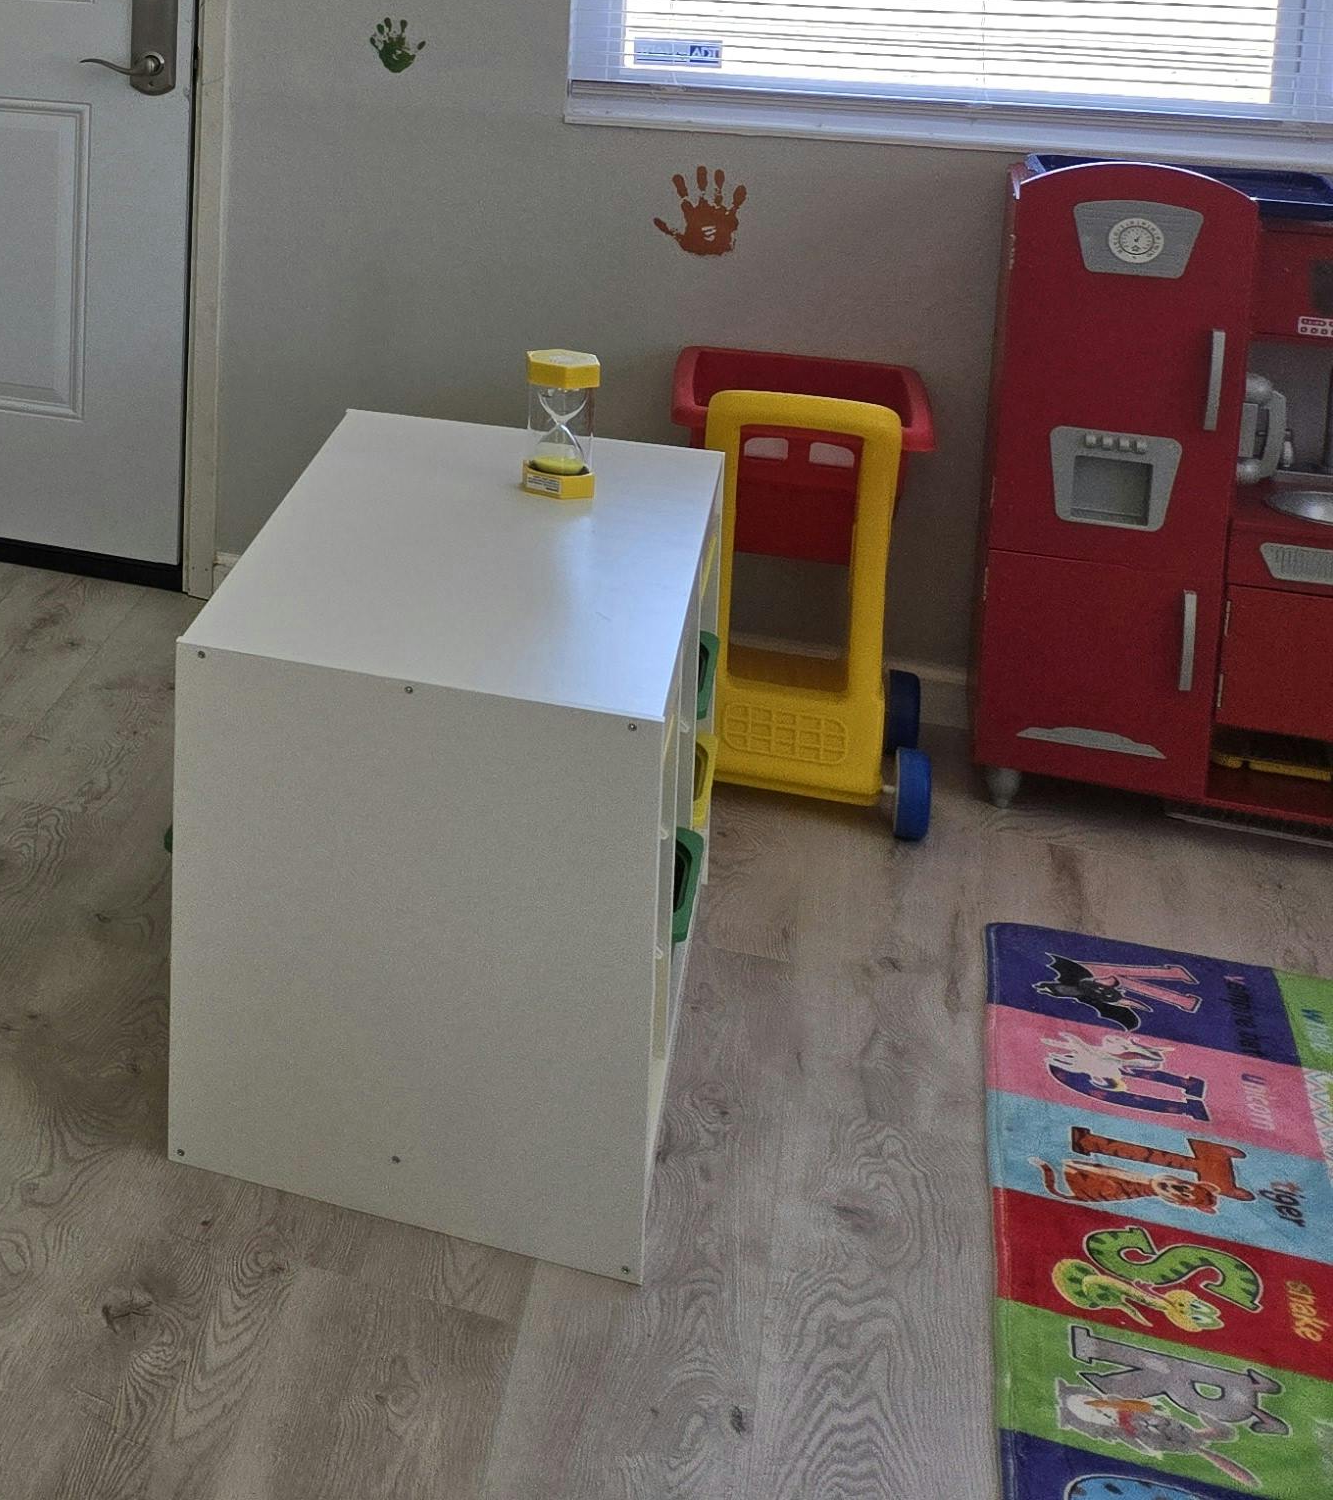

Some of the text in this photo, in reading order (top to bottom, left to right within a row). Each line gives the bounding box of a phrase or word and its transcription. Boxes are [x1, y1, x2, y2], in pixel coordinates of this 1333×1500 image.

[1240, 1072, 1277, 1132] unicorn
[1258, 1180, 1307, 1228] tiger
[1083, 1225, 1264, 1313] S
[1284, 1278, 1331, 1343] snake
[1069, 1324, 1290, 1435] R
